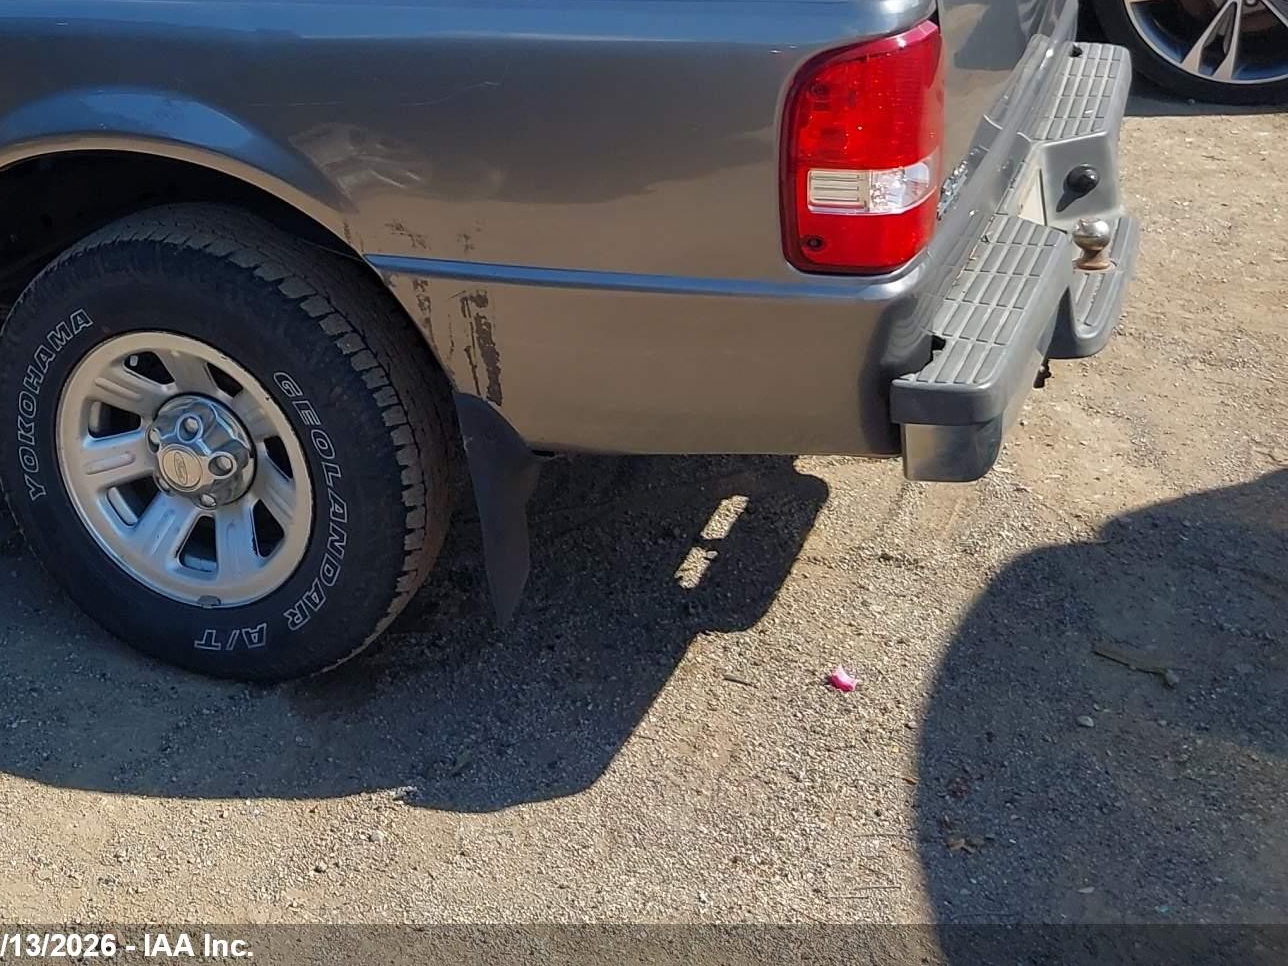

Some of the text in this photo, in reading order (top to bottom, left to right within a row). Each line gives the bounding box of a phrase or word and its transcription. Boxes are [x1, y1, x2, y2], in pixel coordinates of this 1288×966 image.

[18, 308, 94, 501] YOKOHAMA
[194, 371, 348, 651] GEOLANDAR A/T
